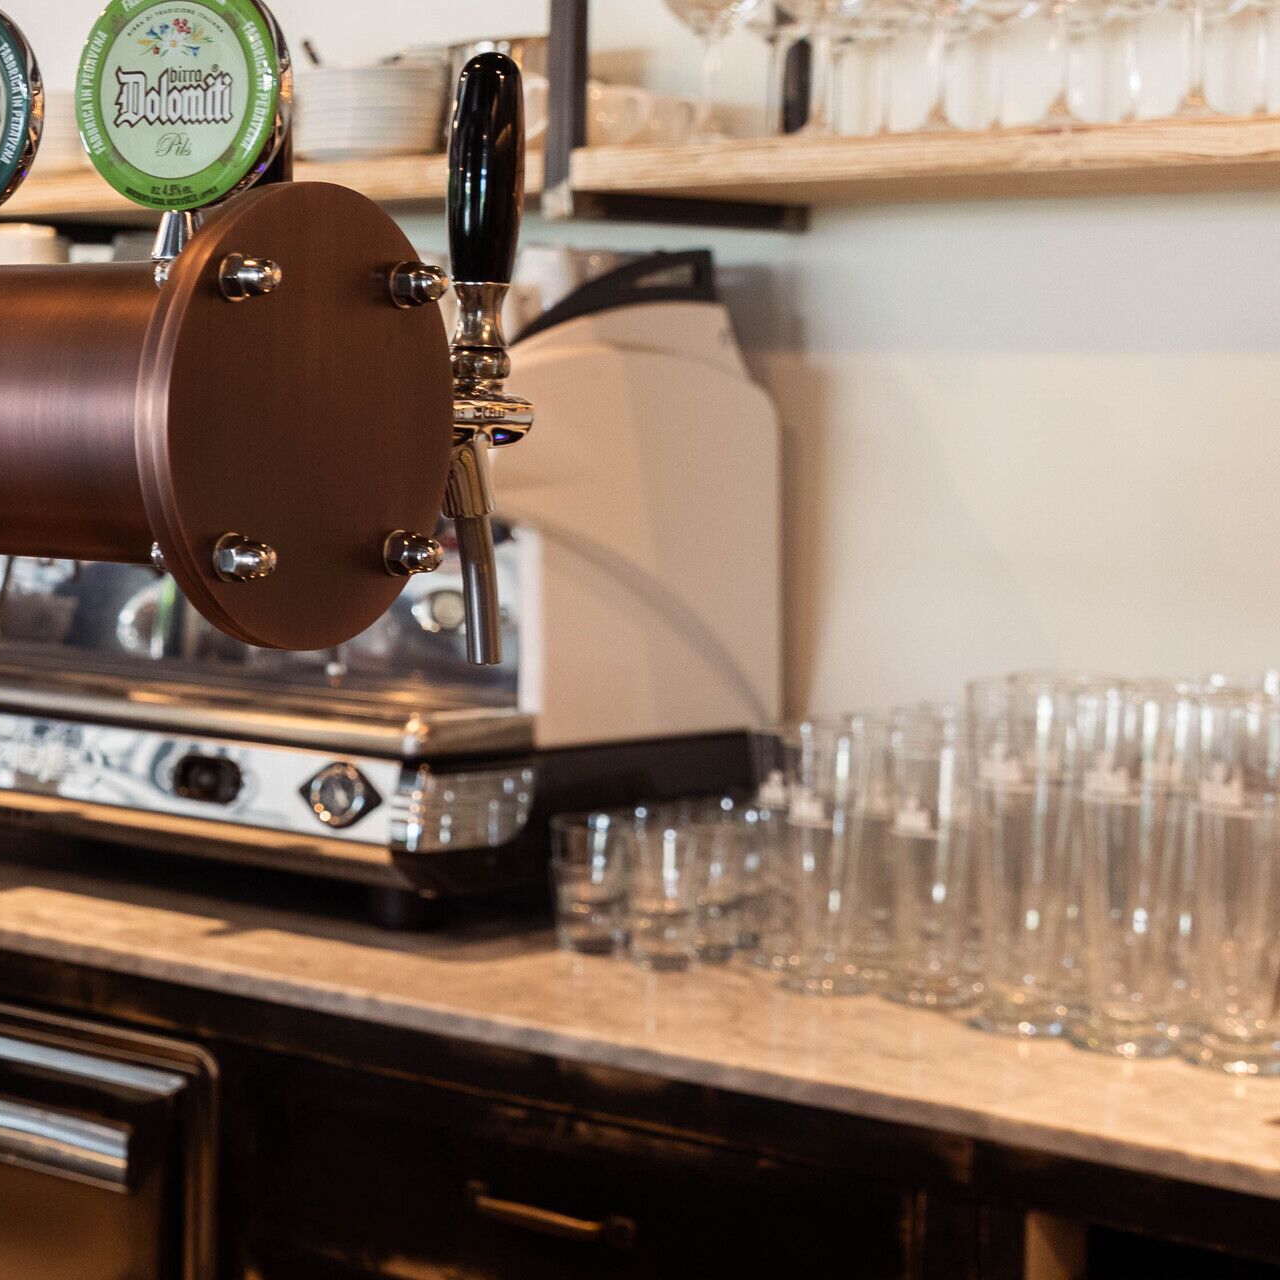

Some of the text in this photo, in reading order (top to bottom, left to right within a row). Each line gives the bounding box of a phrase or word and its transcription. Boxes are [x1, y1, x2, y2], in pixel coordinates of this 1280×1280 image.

[81, 29, 108, 155] FABBRICA IN PEDAVENA
[114, 66, 233, 128] Dolomiti
[169, 66, 201, 83] birra
[0, 110, 25, 165] PEDAVENA
[155, 132, 191, 157] Pils
